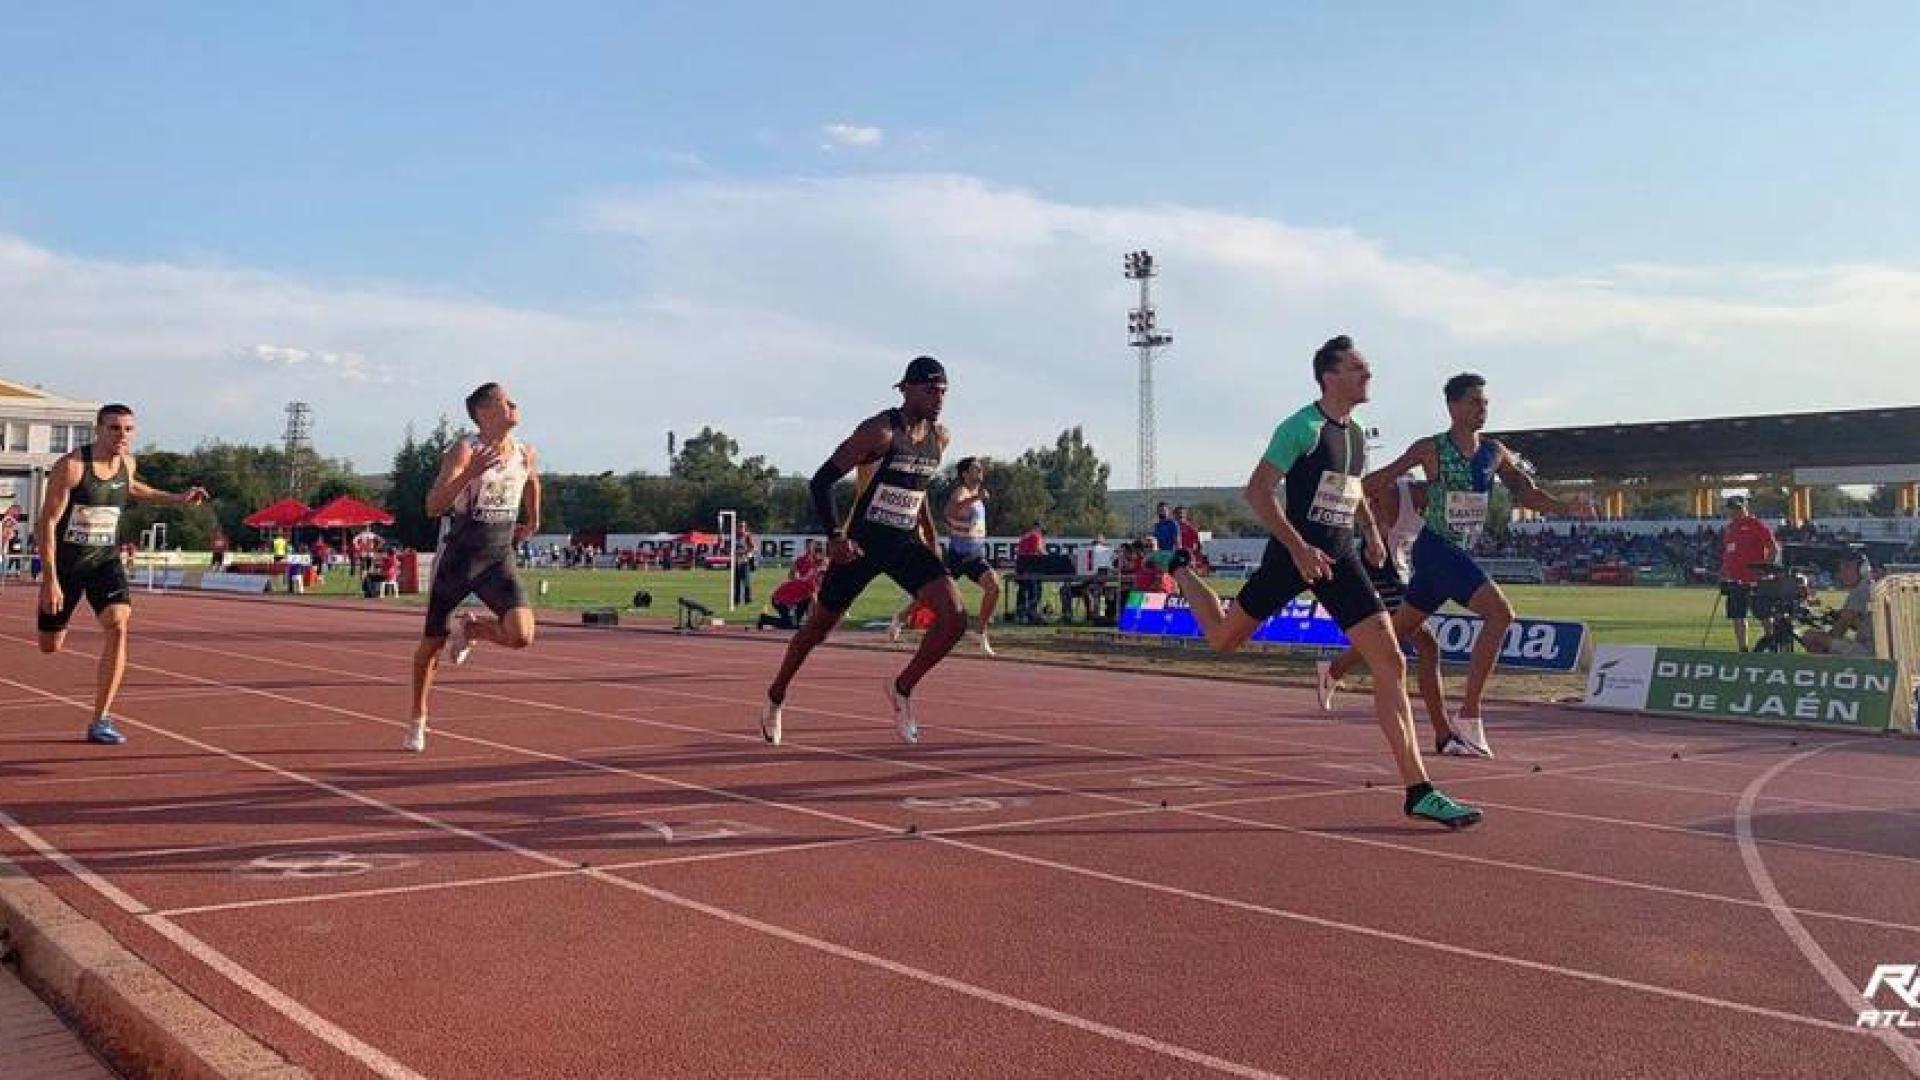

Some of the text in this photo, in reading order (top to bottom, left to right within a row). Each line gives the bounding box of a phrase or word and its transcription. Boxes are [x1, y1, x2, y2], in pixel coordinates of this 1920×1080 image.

[1656, 660, 1890, 692] DIPUTACIÓN
[1672, 691, 1860, 722] DE JAÉN
